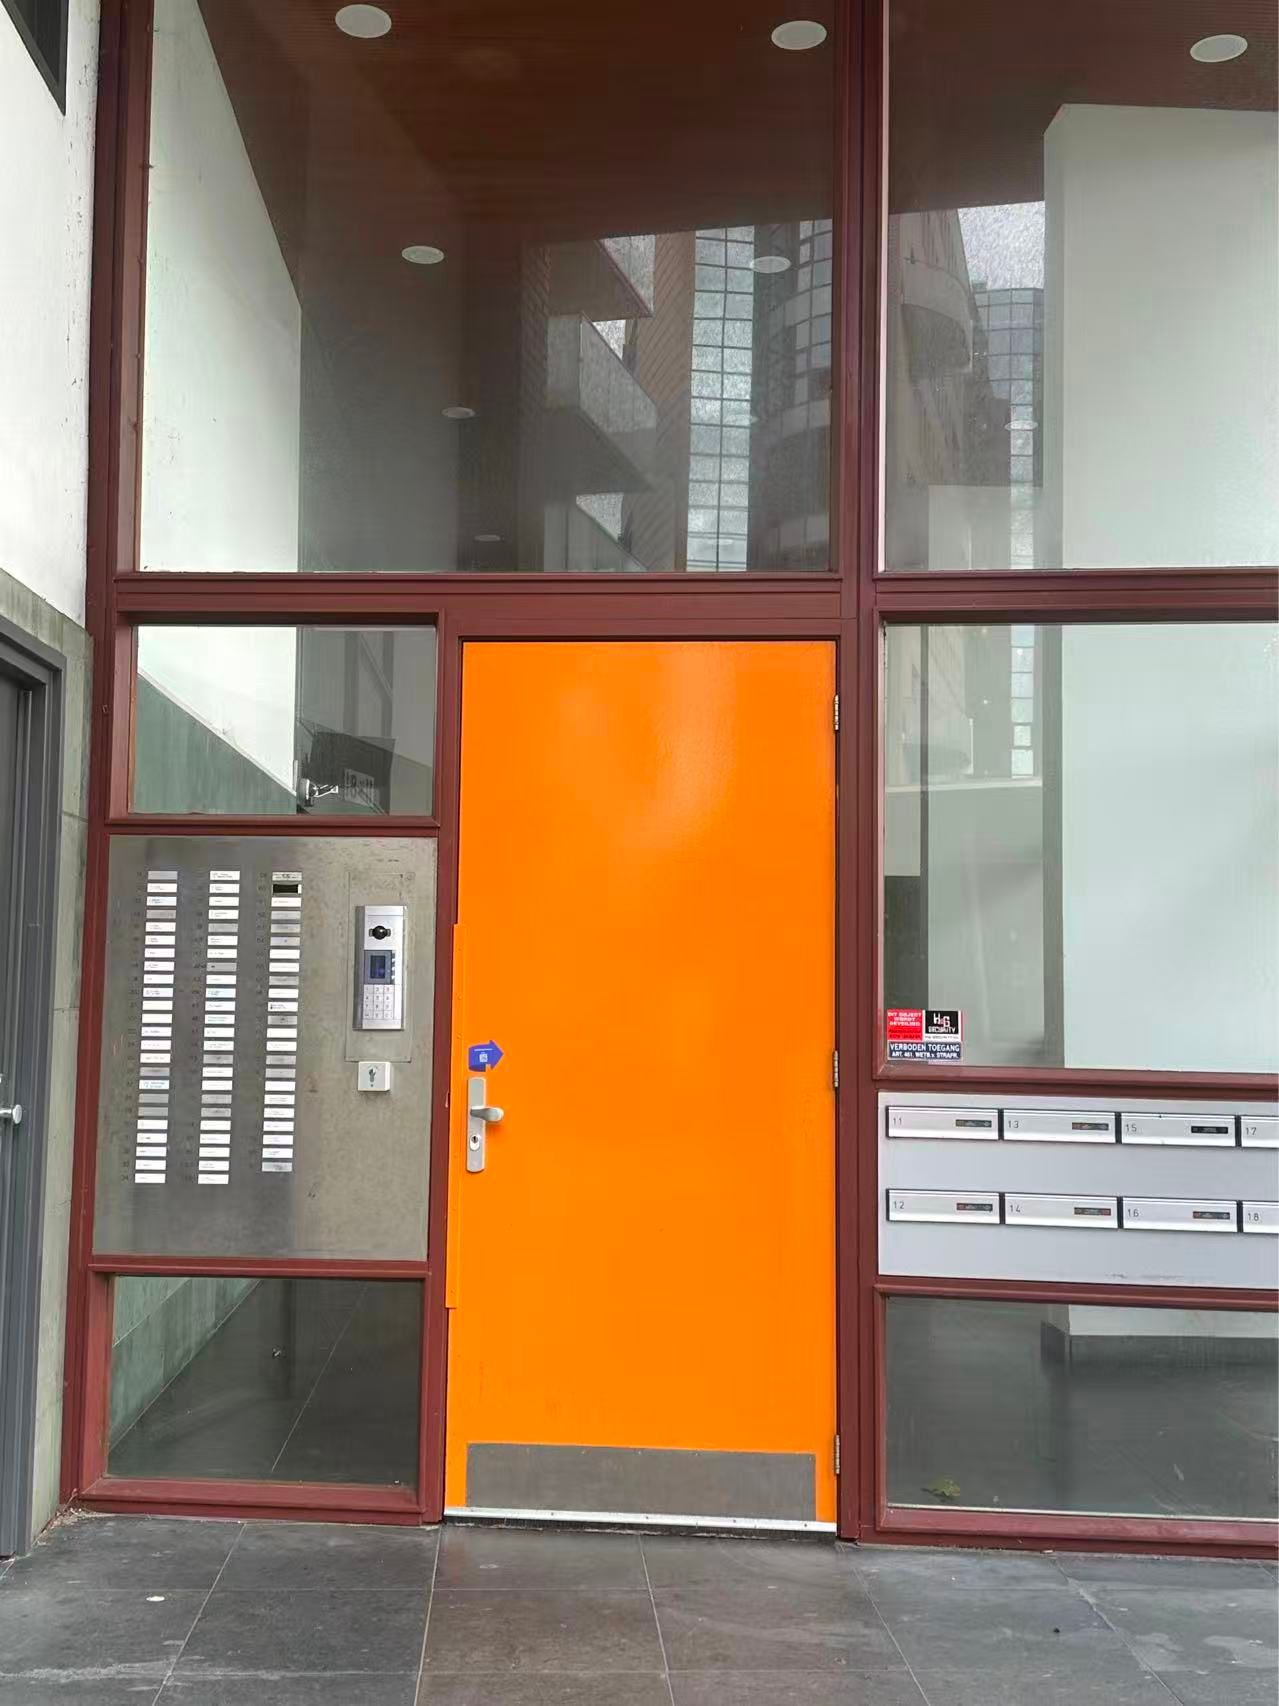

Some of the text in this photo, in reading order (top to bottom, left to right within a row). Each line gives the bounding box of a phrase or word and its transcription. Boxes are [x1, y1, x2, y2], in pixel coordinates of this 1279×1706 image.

[890, 1043, 960, 1052] VERBODEN TOEGANG
[893, 1117, 902, 1125] 11
[1008, 1120, 1019, 1128] 13
[1125, 1123, 1137, 1132] 15
[1246, 1127, 1257, 1136] 17
[894, 1201, 905, 1210] 12
[1010, 1204, 1021, 1213] 14
[1128, 1209, 1139, 1218] 16
[1248, 1213, 1259, 1222] 18
